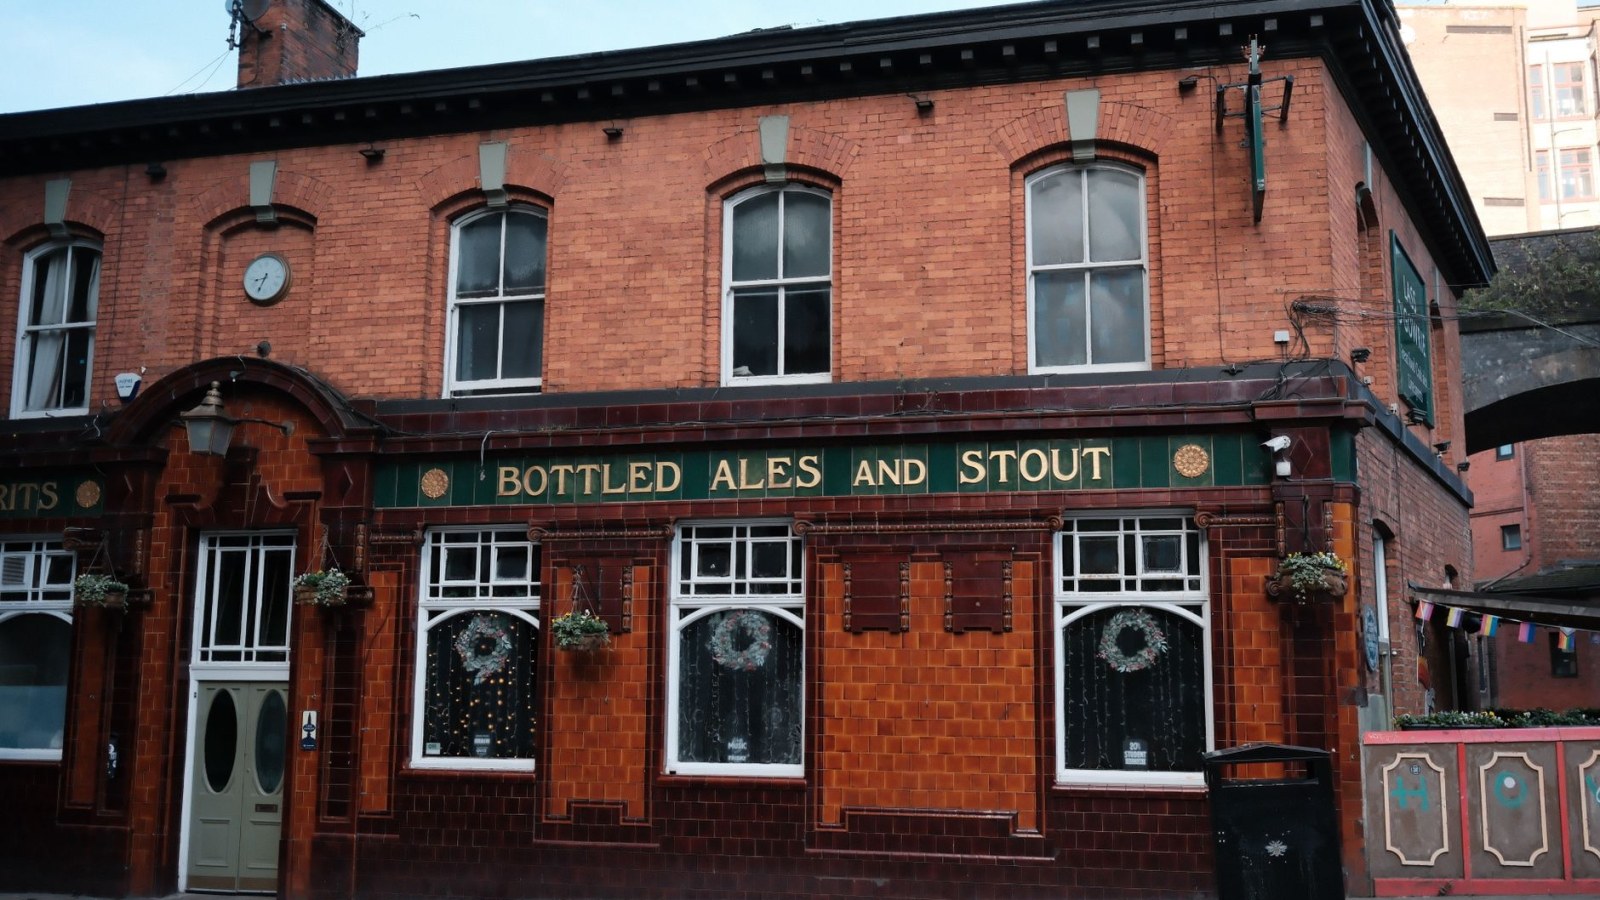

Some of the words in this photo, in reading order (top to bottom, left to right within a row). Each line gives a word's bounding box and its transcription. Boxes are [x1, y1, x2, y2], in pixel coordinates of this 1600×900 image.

[497, 461, 682, 496] BOTTLED
[710, 455, 822, 490] ALES
[853, 458, 926, 486] AND
[960, 447, 1110, 484] STOUT
